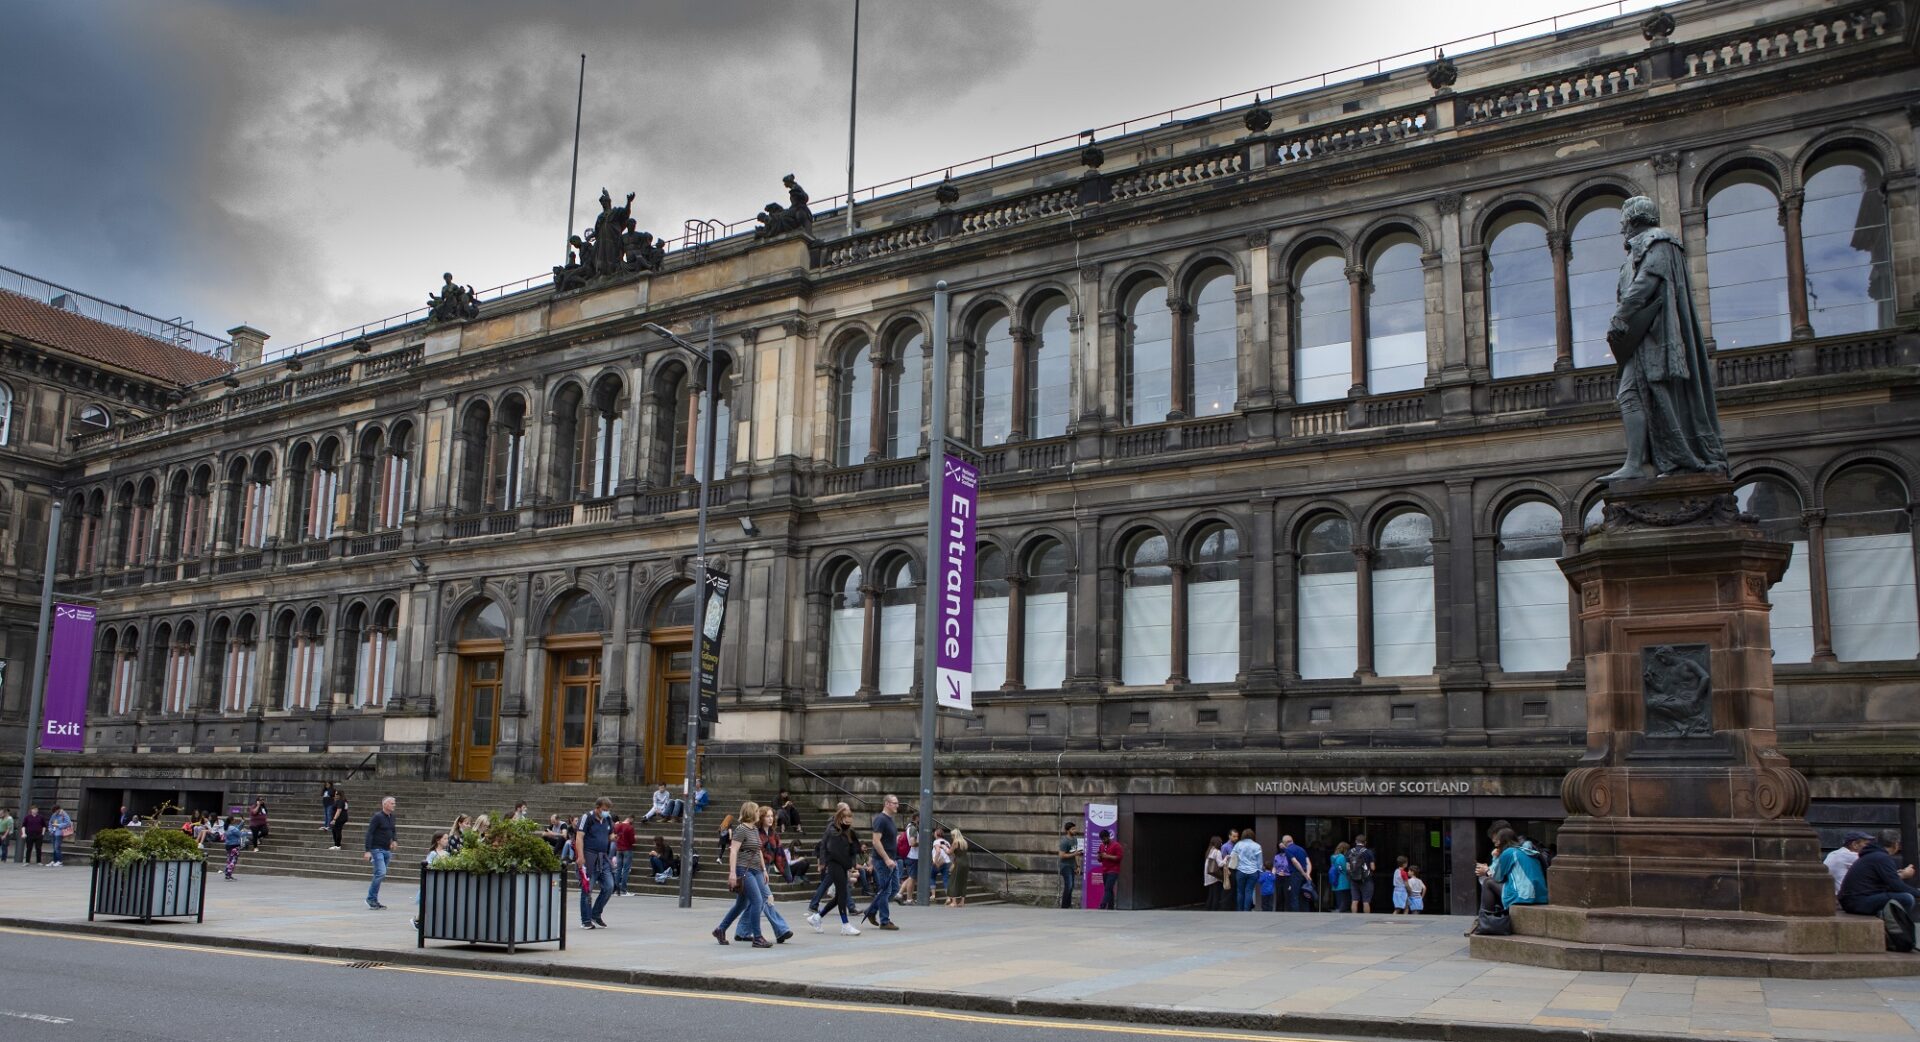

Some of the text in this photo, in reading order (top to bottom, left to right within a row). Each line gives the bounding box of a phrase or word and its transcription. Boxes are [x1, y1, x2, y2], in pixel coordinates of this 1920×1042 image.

[945, 494, 970, 659] Entrance
[47, 719, 80, 736] Exit
[1255, 781, 1470, 793] NATIONAL MUSEUM OF SCOTLAND
